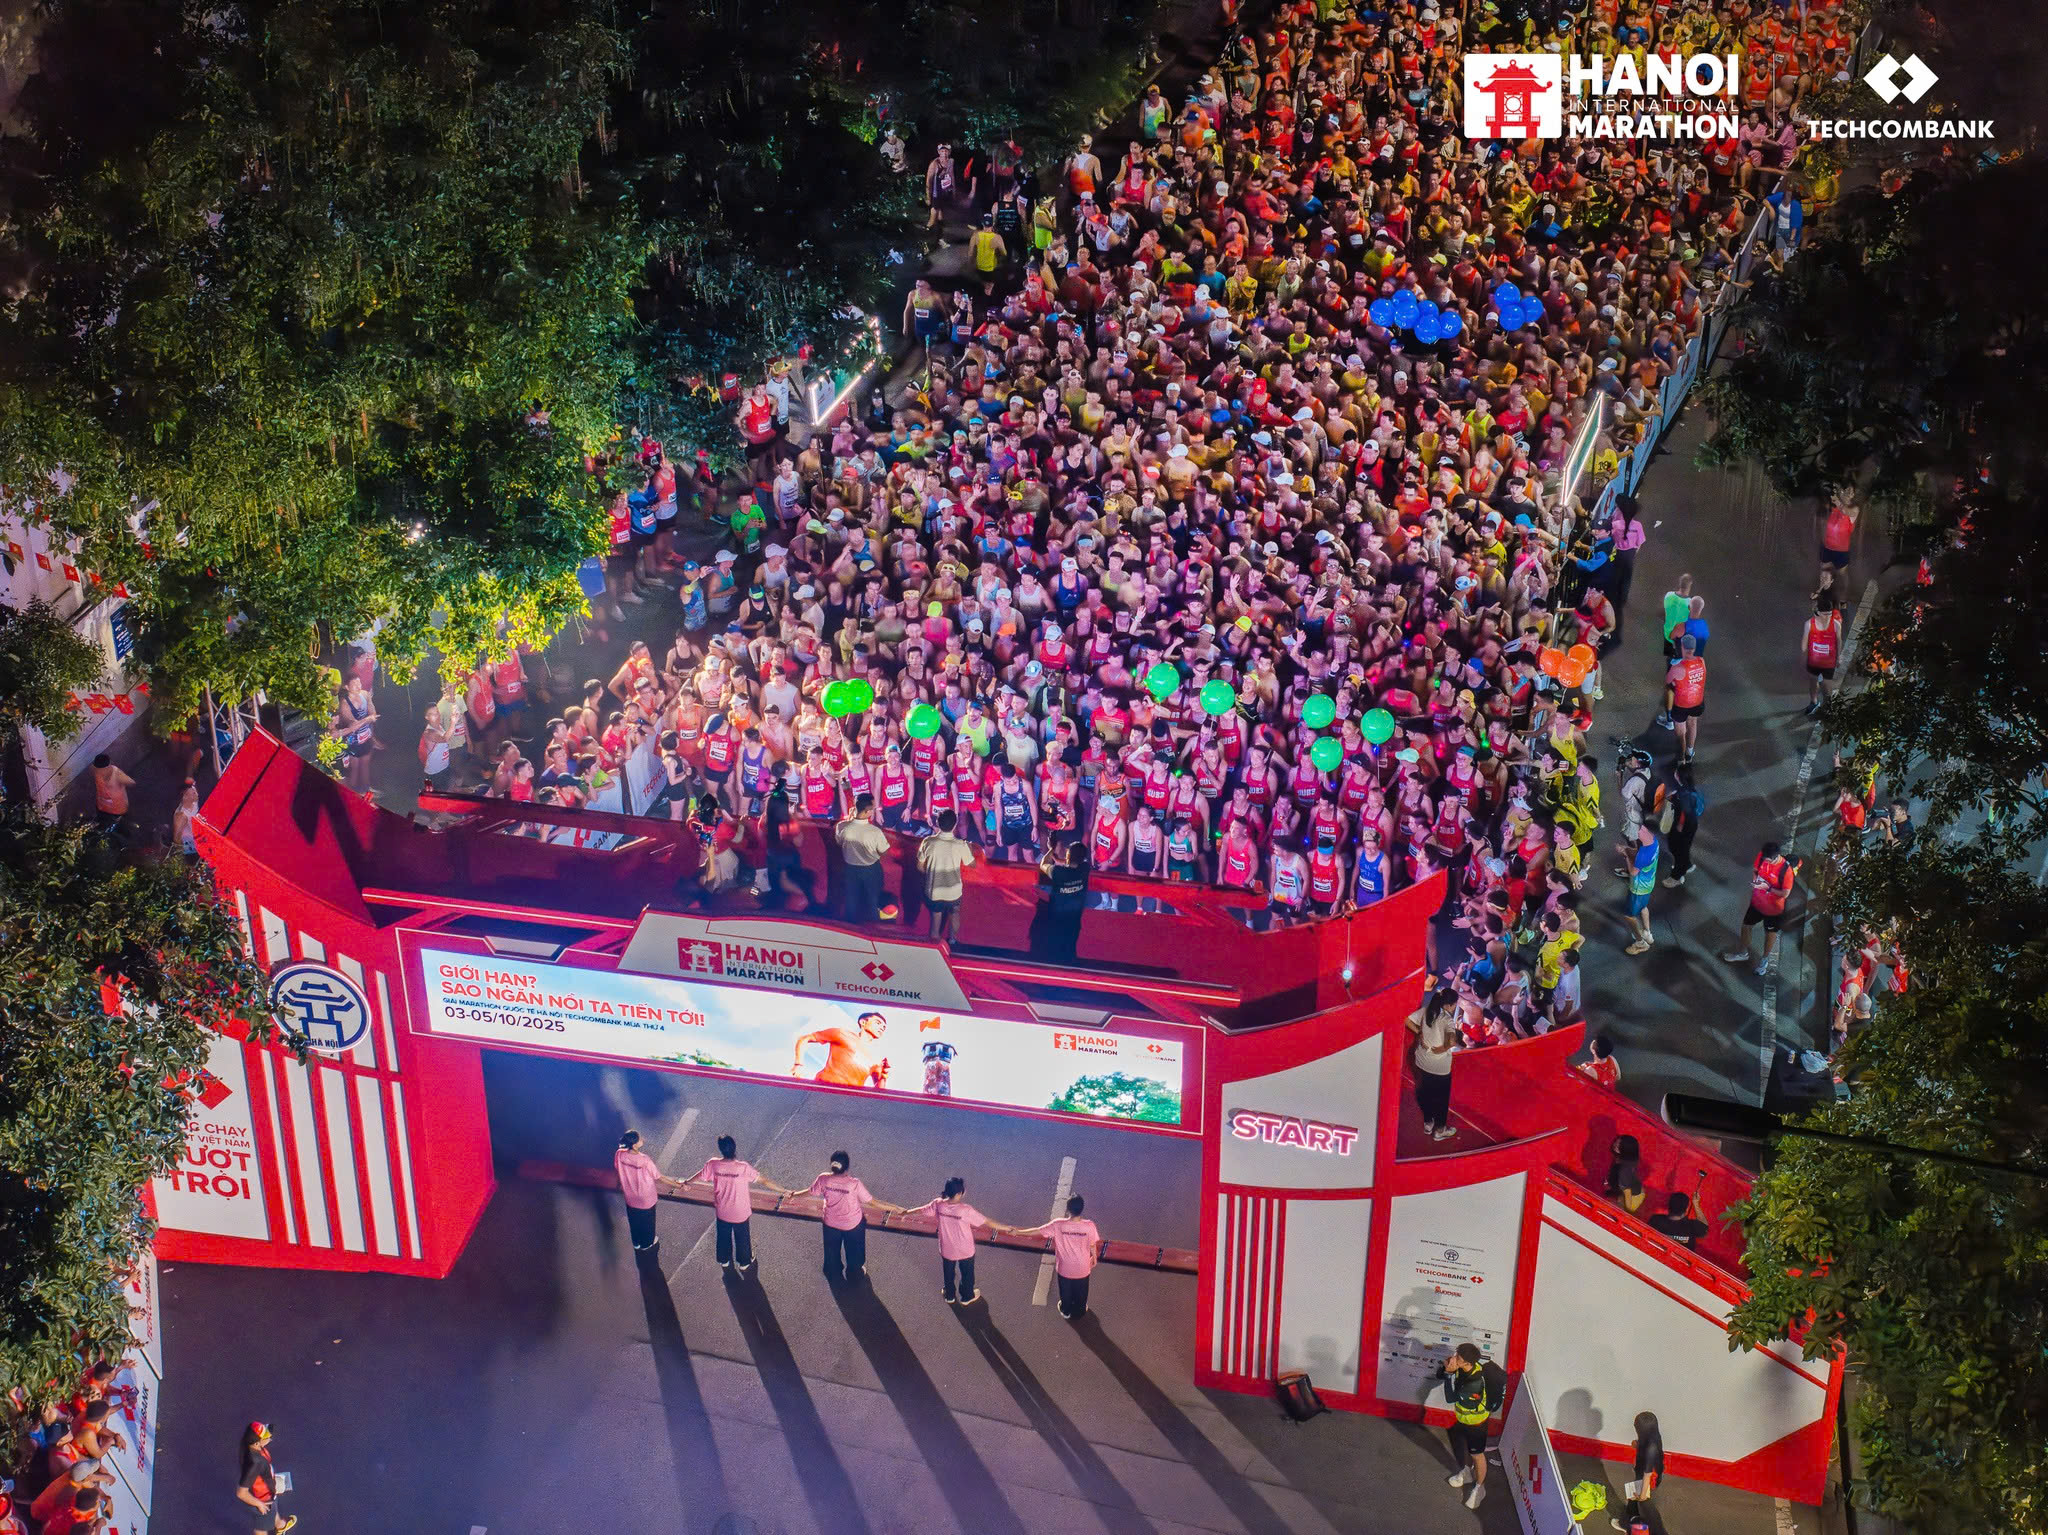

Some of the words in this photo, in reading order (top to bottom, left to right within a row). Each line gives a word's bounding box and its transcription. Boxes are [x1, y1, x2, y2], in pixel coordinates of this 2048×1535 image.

[725, 944, 803, 968] HANOI
[440, 965, 479, 981] GIỚI
[726, 960, 804, 975] INTERNATIONAL
[727, 967, 804, 984] MARATHON
[442, 982, 481, 997] SAO
[589, 1000, 614, 1015] TA
[835, 981, 922, 1000] TECHCOMBANK
[445, 1006, 565, 1032] 03-05/10/2025
[459, 999, 501, 1010] MARATHON
[565, 1013, 621, 1026] TECHCOMBANK
[1078, 1036, 1118, 1047] HANOI
[1078, 1047, 1118, 1056] MARATHON
[204, 1123, 247, 1139] CHẠY
[1231, 1111, 1358, 1155] START
[225, 1139, 250, 1149] NAM
[184, 1144, 251, 1172] ƯỢT
[168, 1169, 251, 1200] TRỘI
[1416, 1268, 1467, 1281] TECHCOMBANK
